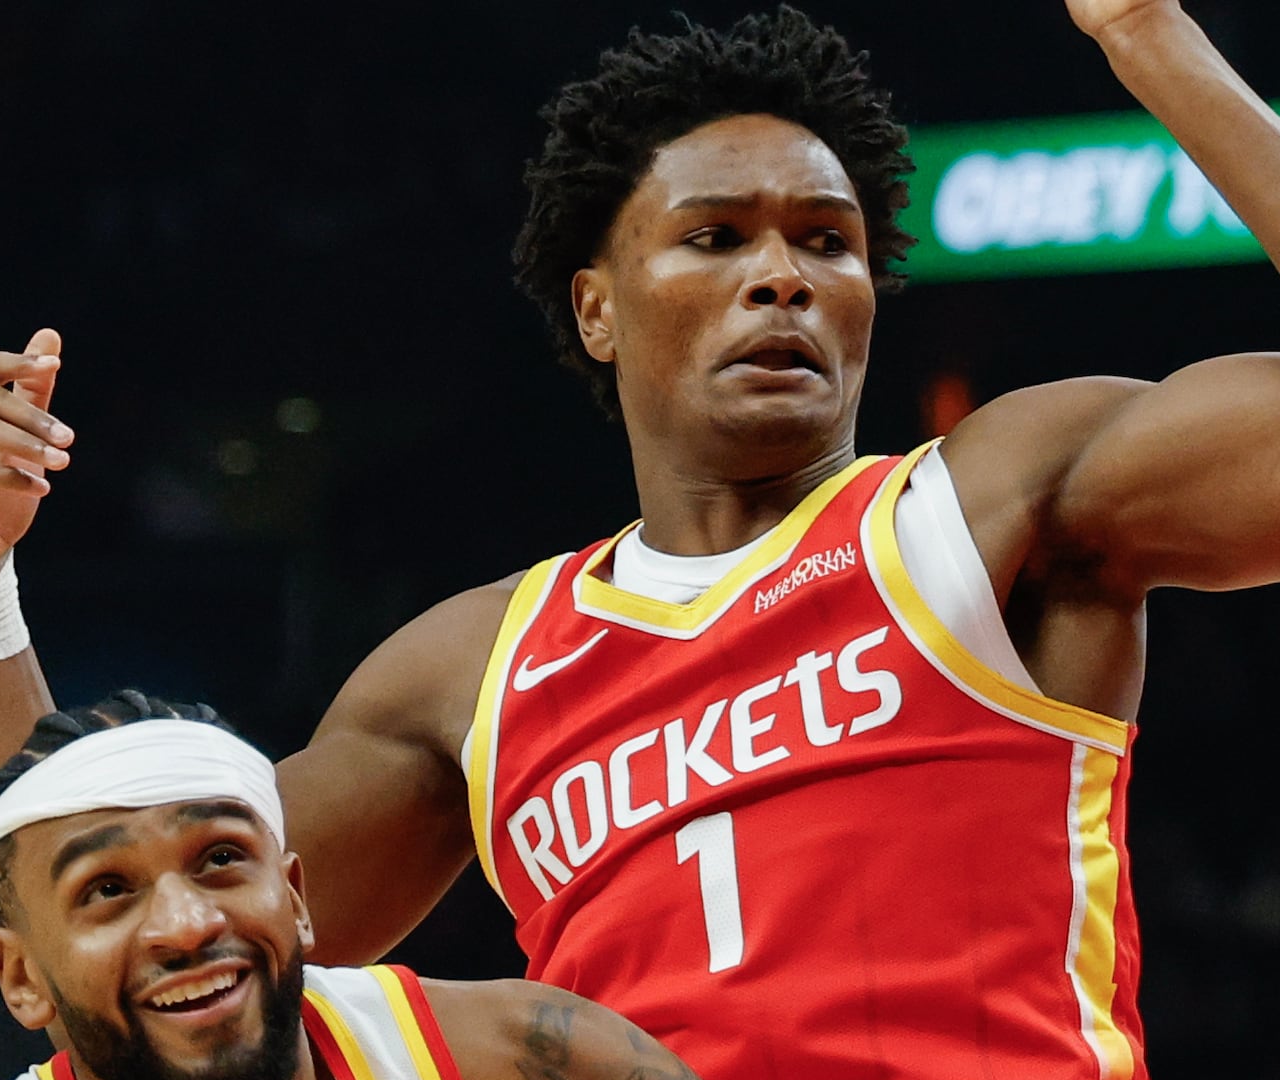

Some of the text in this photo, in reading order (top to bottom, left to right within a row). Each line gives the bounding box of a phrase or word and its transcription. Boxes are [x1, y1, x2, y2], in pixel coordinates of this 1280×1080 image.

[932, 146, 1168, 254] OBEY
[753, 549, 856, 614] HERMANN
[755, 542, 856, 603] MEMORIAL
[506, 627, 902, 902] ROCKETS
[676, 811, 743, 973] 1
